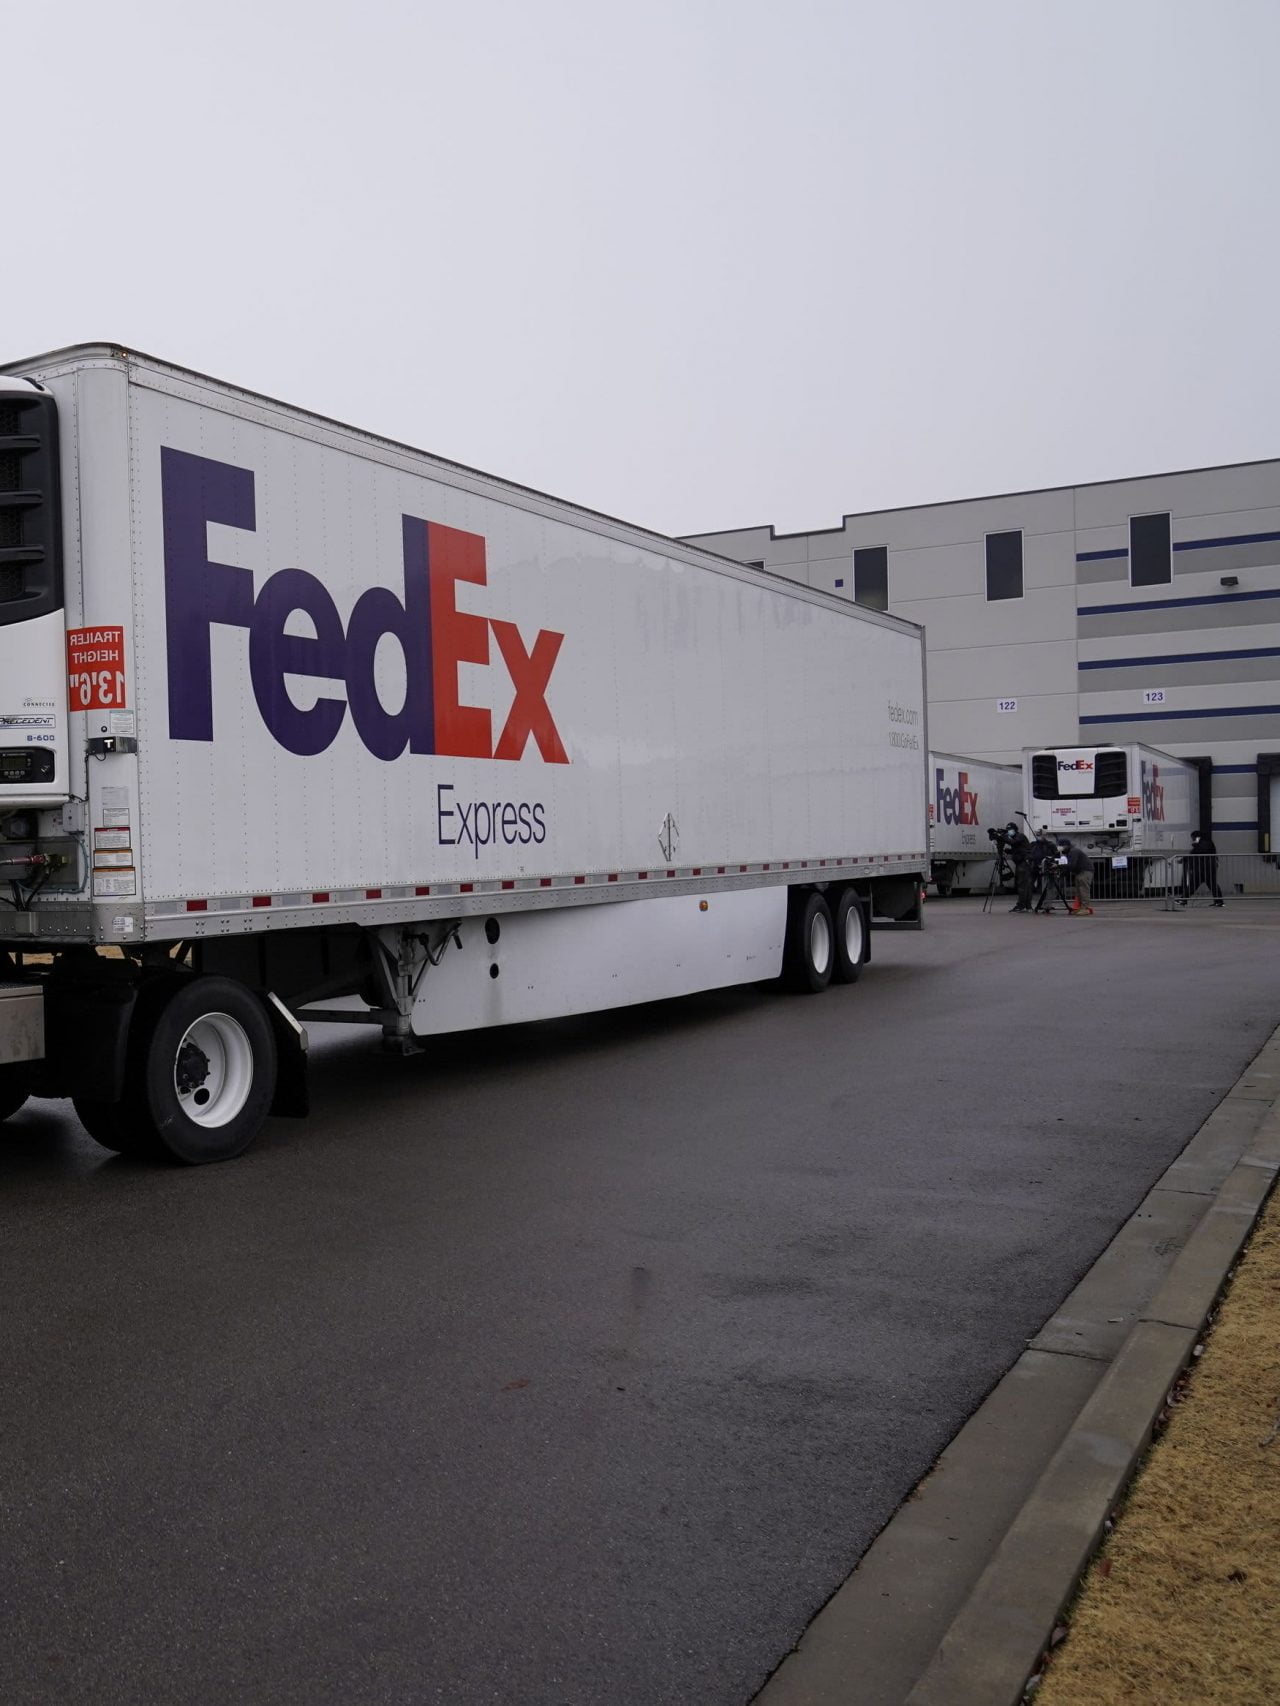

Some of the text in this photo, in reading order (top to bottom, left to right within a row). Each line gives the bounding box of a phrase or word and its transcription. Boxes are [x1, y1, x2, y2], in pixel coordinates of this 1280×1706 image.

[160, 445, 570, 764] FedEx
[999, 701, 1016, 710] 122
[1145, 692, 1163, 701] 123
[1057, 760, 1093, 771] FedEx
[936, 768, 979, 826] FedEx
[437, 784, 546, 859] Express
